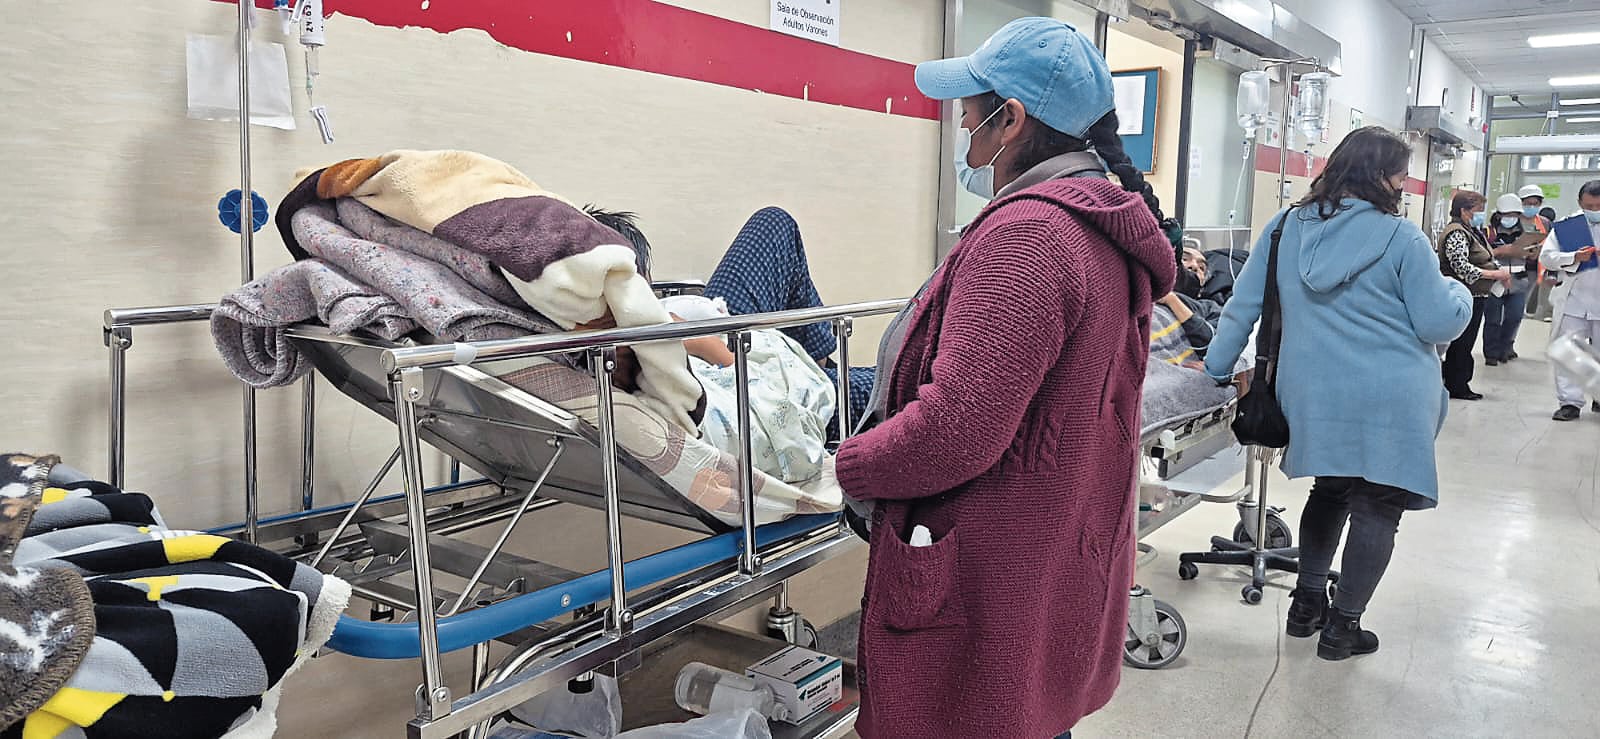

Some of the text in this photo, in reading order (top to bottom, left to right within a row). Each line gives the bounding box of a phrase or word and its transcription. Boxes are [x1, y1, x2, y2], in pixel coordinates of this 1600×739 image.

[777, 1, 790, 14] Sala
[791, 7, 799, 16] de
[782, 17, 828, 37] Adultos Varones
